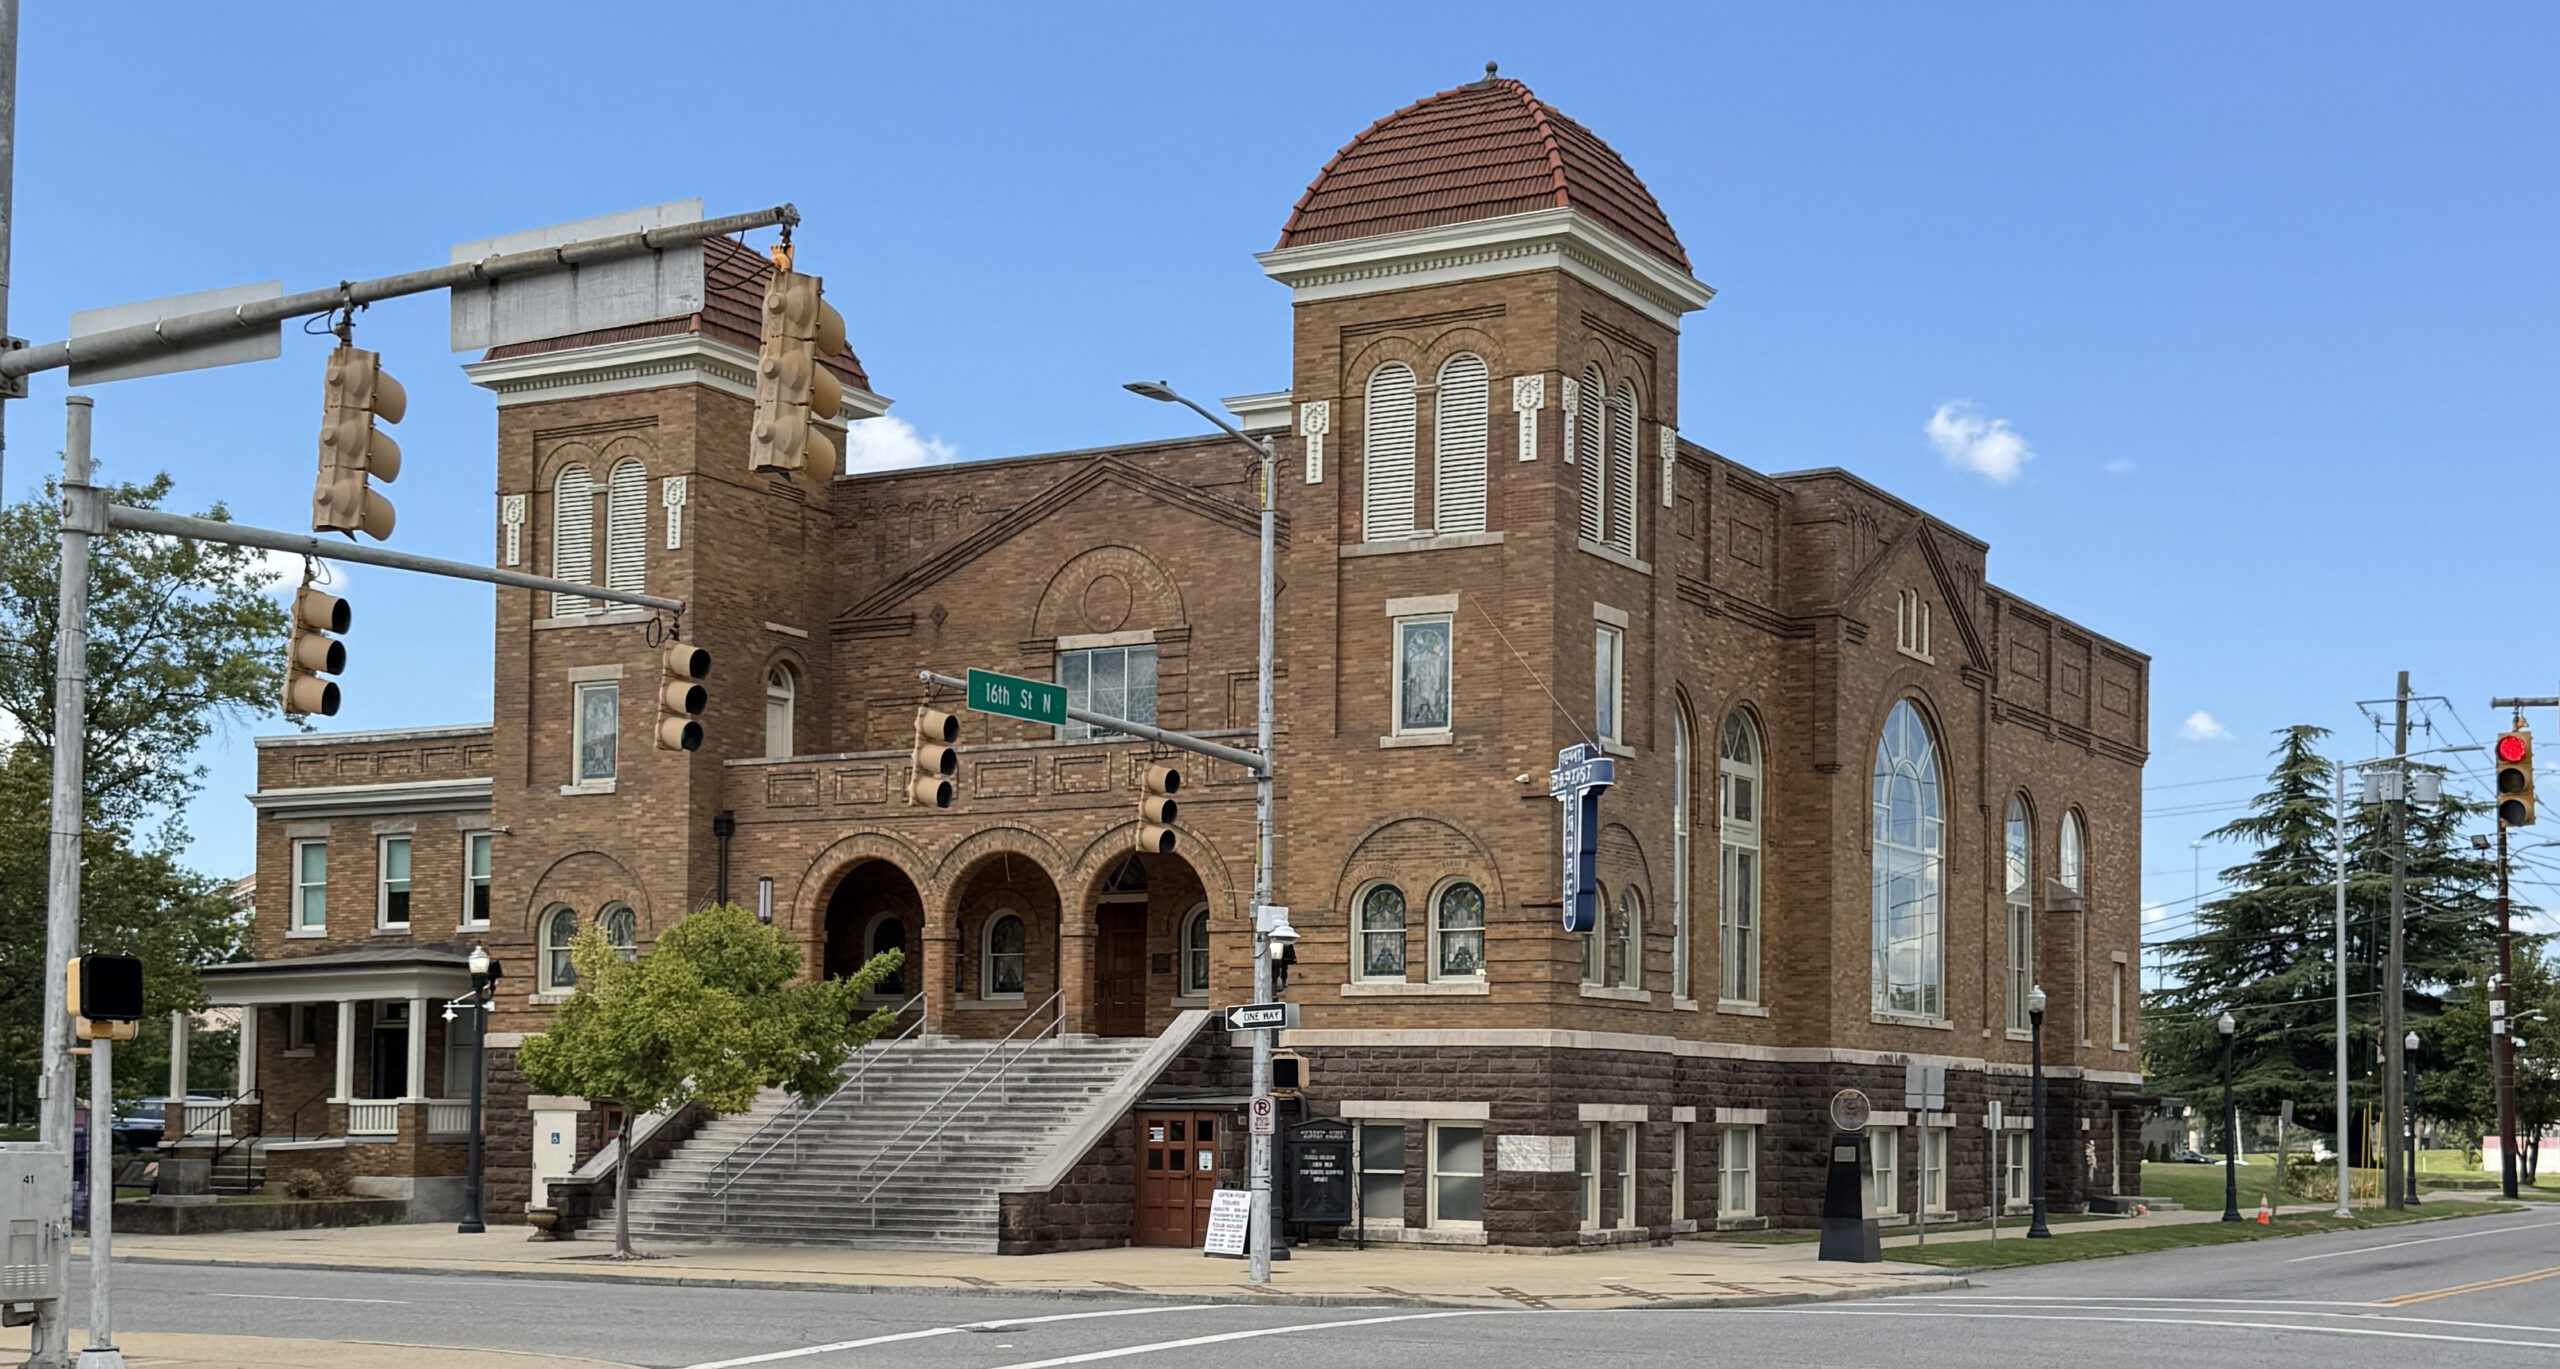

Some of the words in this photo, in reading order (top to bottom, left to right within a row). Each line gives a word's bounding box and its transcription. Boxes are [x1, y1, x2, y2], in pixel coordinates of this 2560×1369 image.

[985, 682, 1010, 706] 16th
[1019, 688, 1033, 710] St
[1042, 692, 1052, 714] N
[1551, 764, 1592, 791] BAPTIST
[1564, 793, 1575, 917] CHURCH
[1243, 1011, 1260, 1022] ONE
[1262, 1010, 1280, 1021] WAY
[22, 1174, 35, 1185] 41
